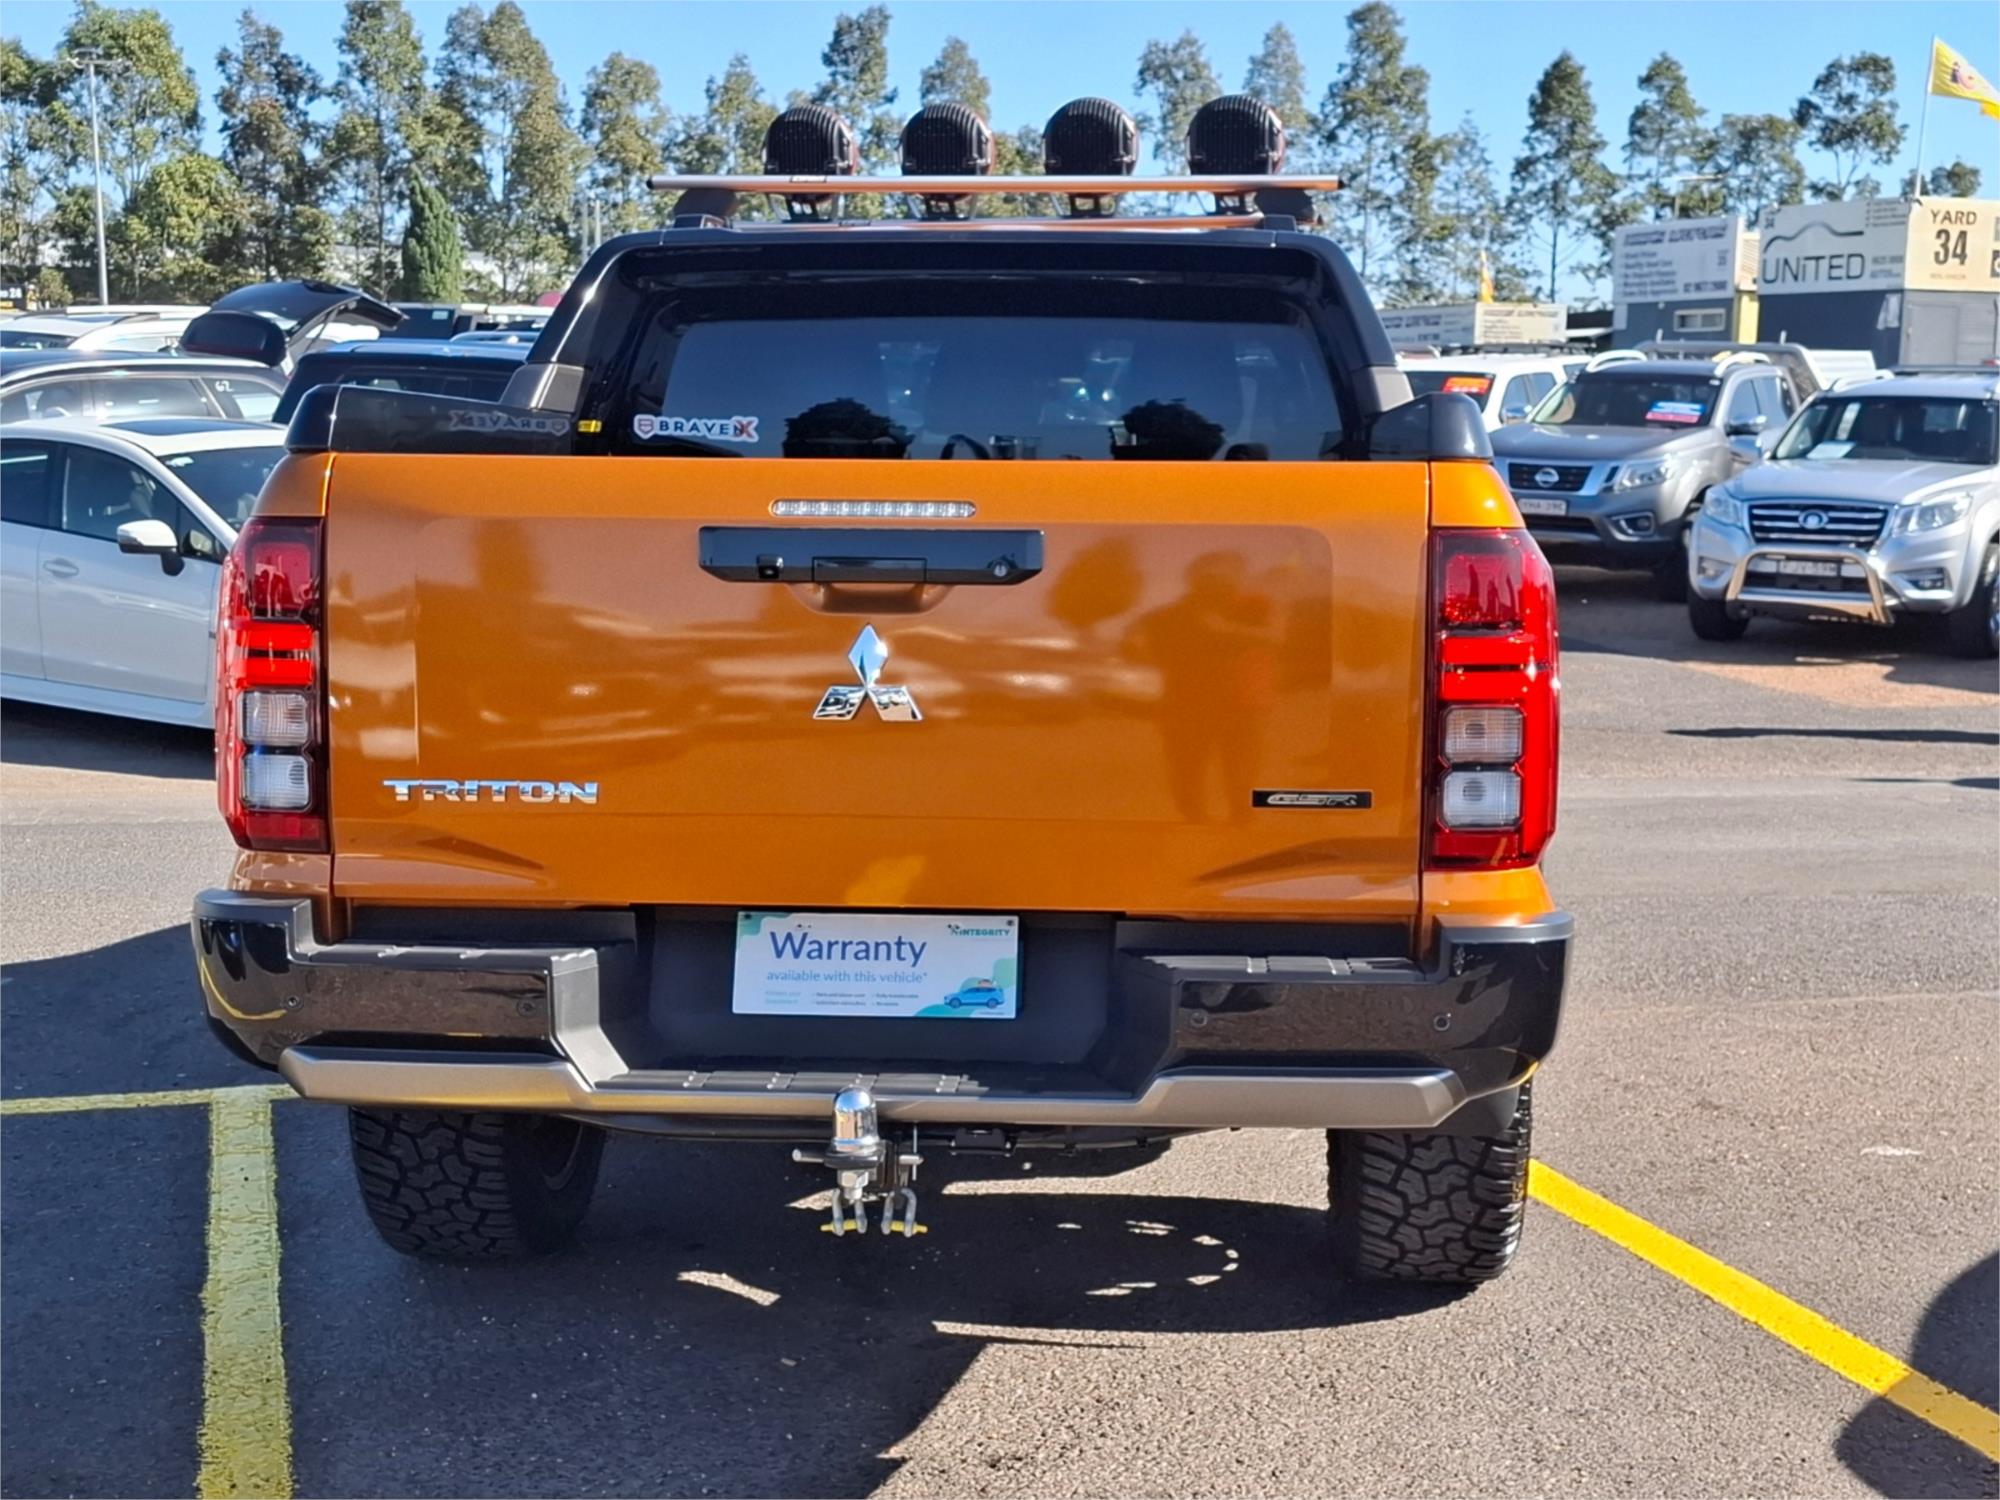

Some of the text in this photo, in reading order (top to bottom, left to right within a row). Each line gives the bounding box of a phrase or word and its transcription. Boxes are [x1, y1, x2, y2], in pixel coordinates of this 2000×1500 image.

[1930, 209, 1978, 225] YARD
[1934, 228, 1968, 266] 34
[383, 779, 598, 804] TRITON
[769, 930, 927, 967] Warranty
[766, 969, 821, 983] available
[823, 969, 851, 983] with
[854, 970, 877, 983] this
